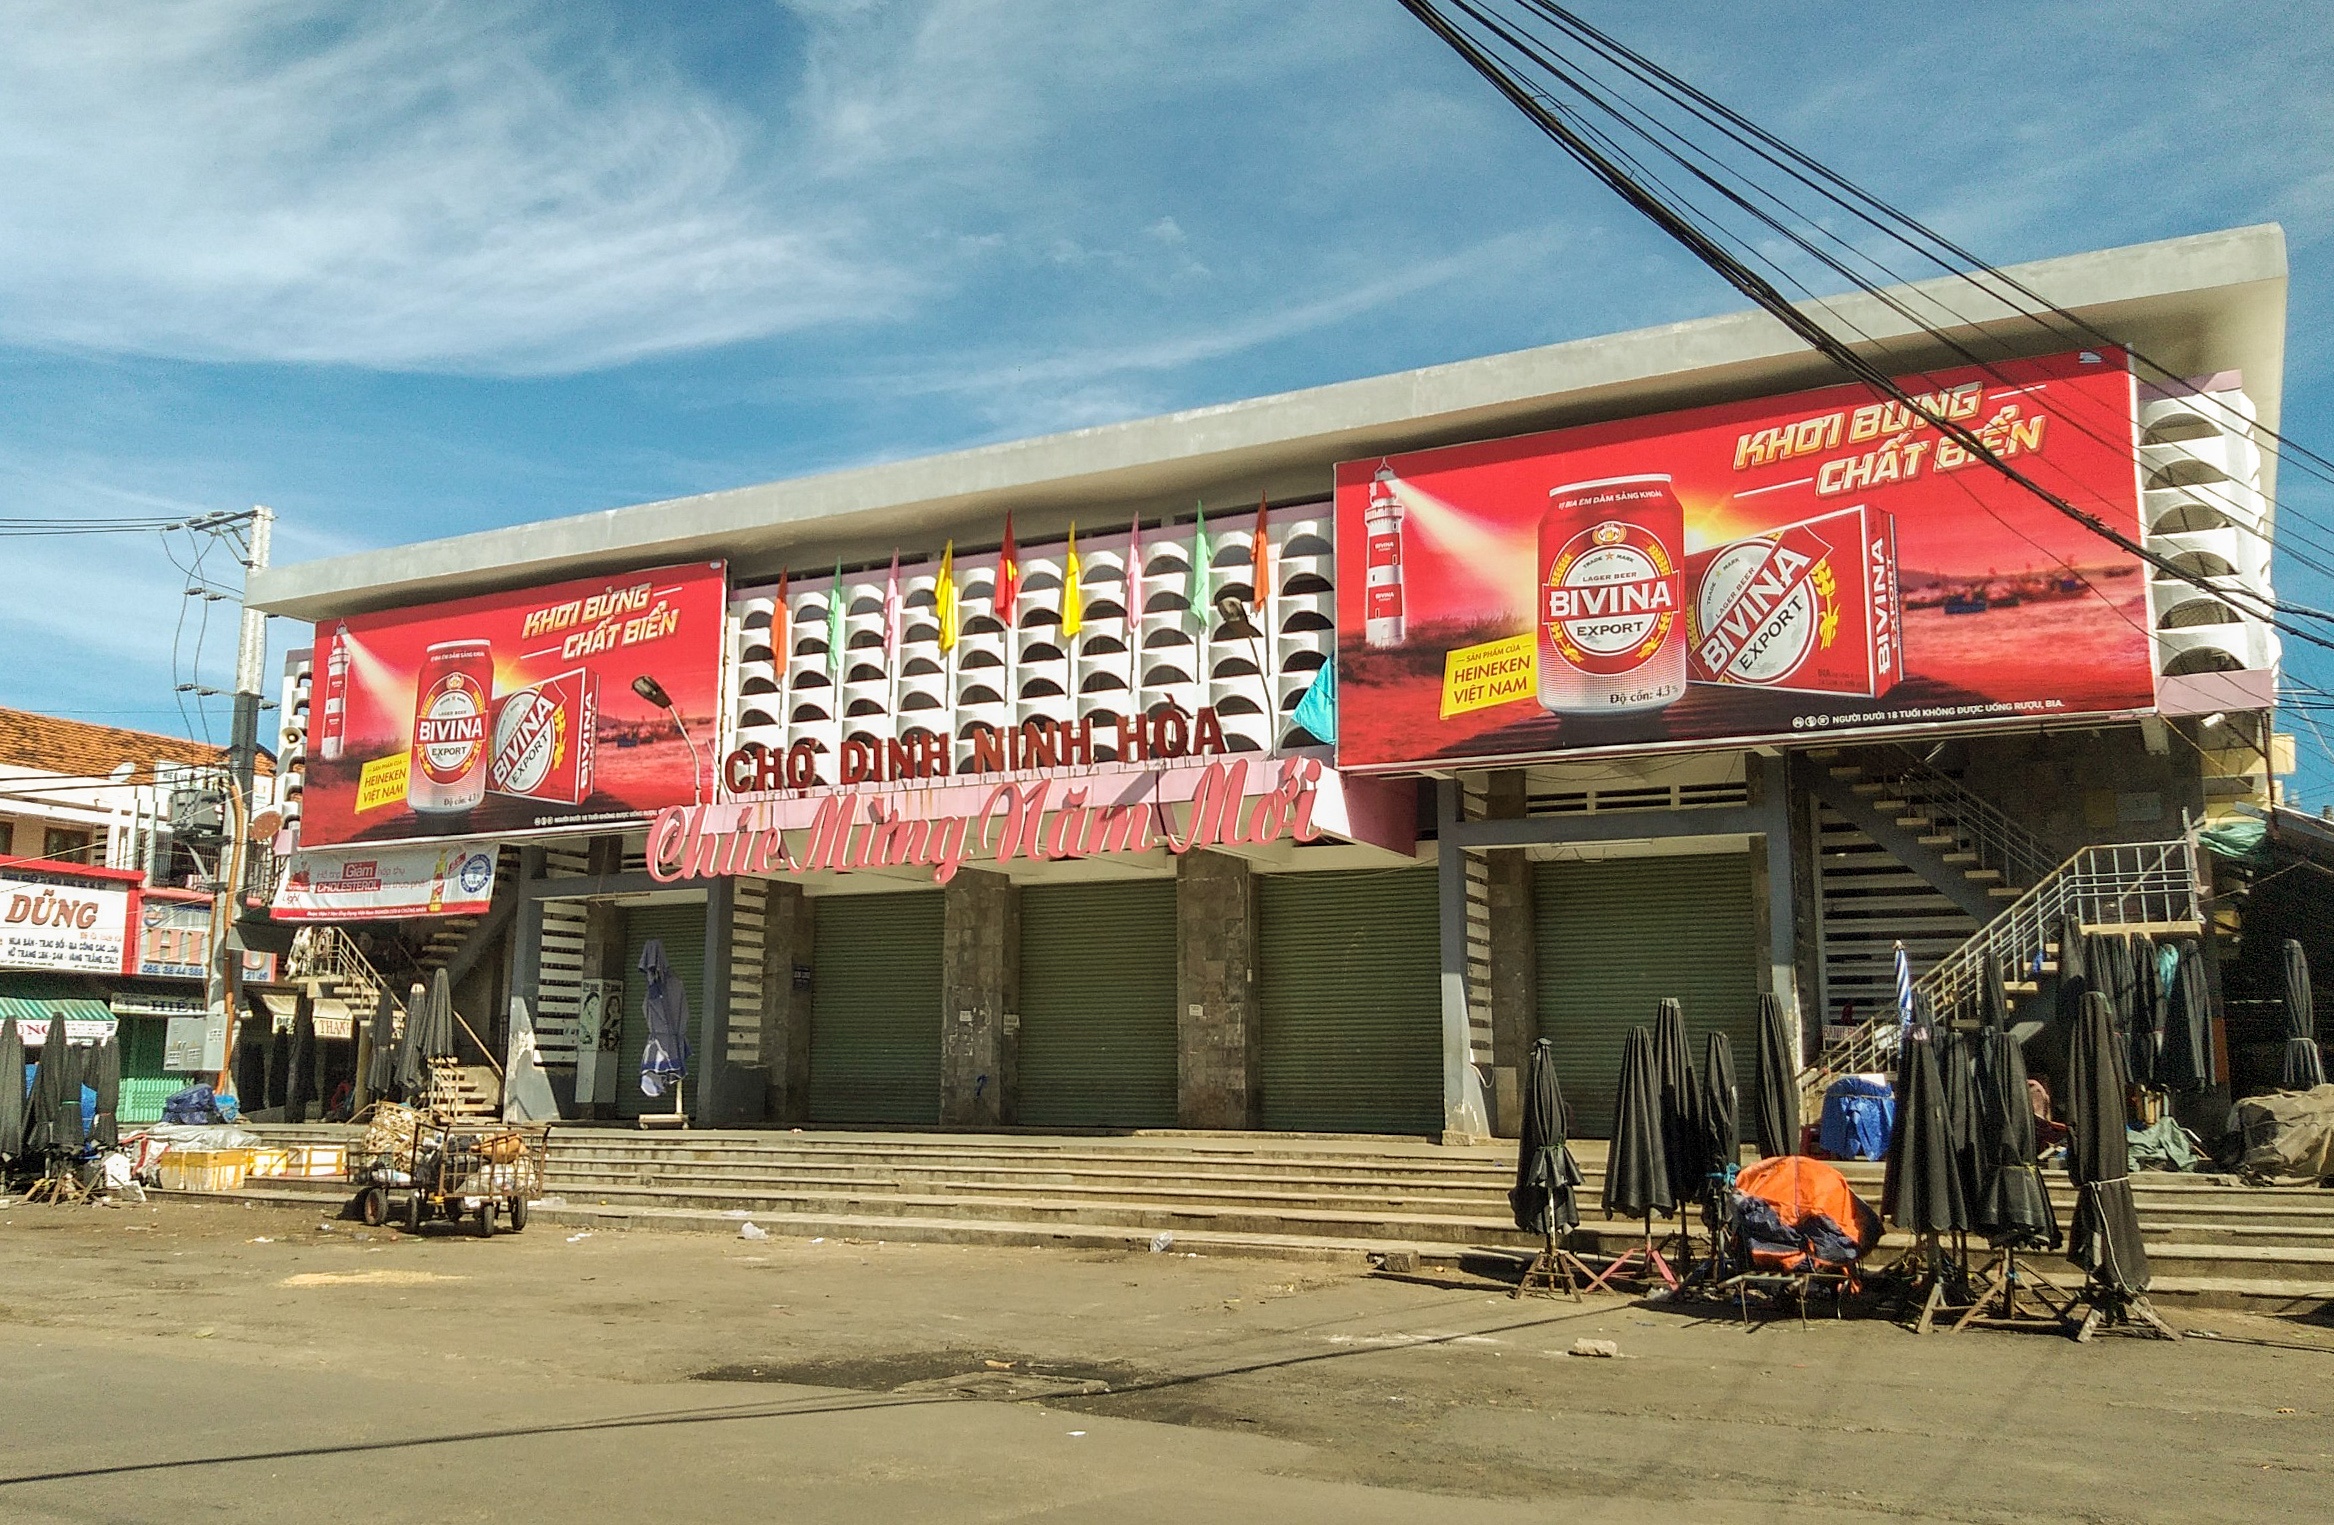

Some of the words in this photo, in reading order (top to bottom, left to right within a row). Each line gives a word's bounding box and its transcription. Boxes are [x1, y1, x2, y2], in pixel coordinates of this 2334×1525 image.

[1733, 412, 1845, 470] KHƠI
[1816, 430, 1930, 496] CHẤT
[1582, 574, 1611, 582] LAGER
[1583, 556, 1603, 568] TRADE
[1616, 554, 1634, 564] MARK
[1707, 582, 1716, 605] TRADE
[1723, 557, 1740, 571] MARK
[1549, 581, 1671, 617] BIVINA
[1700, 546, 1811, 675] BIVINA
[1715, 592, 1736, 619] LAGER
[1736, 567, 1755, 592] BEER
[1871, 538, 1891, 675] BIVINA
[1886, 555, 1897, 649] EXPORT
[522, 600, 582, 639] KHƠI
[562, 615, 622, 660] CHẤT
[622, 600, 679, 646] BIỂN
[1577, 622, 1643, 636] EXPORT
[1739, 595, 1803, 671] EXPORT
[1454, 655, 1530, 684] HEINEKEN
[1454, 684, 1484, 704] VIỆT
[1489, 676, 1527, 697] NAM
[420, 718, 483, 741] BIVINA
[1832, 714, 1861, 724] NGƯỜI
[1863, 711, 1885, 721] DƯỚI
[1887, 711, 1898, 719] 18
[1922, 707, 1955, 717] KHÔNG
[432, 747, 467, 756] EXPORT
[493, 696, 555, 786] BIVINA
[512, 731, 548, 783] EXPORT
[581, 692, 592, 789] BIVINA
[725, 738, 820, 798] CHỢ
[841, 732, 951, 785] DINH
[973, 717, 1094, 774] NINH
[1116, 693, 1229, 762] HÒA
[363, 788, 381, 803] VIỆT
[382, 783, 403, 798] NAM
[364, 768, 407, 788] HEINEKEN
[646, 803, 785, 883] Chúc
[789, 793, 973, 884] Mừng
[979, 778, 1157, 864] Năm
[1168, 756, 1323, 854] Mới
[5, 889, 98, 929] DŨNG
[316, 881, 379, 893] CHOLESTEROL
